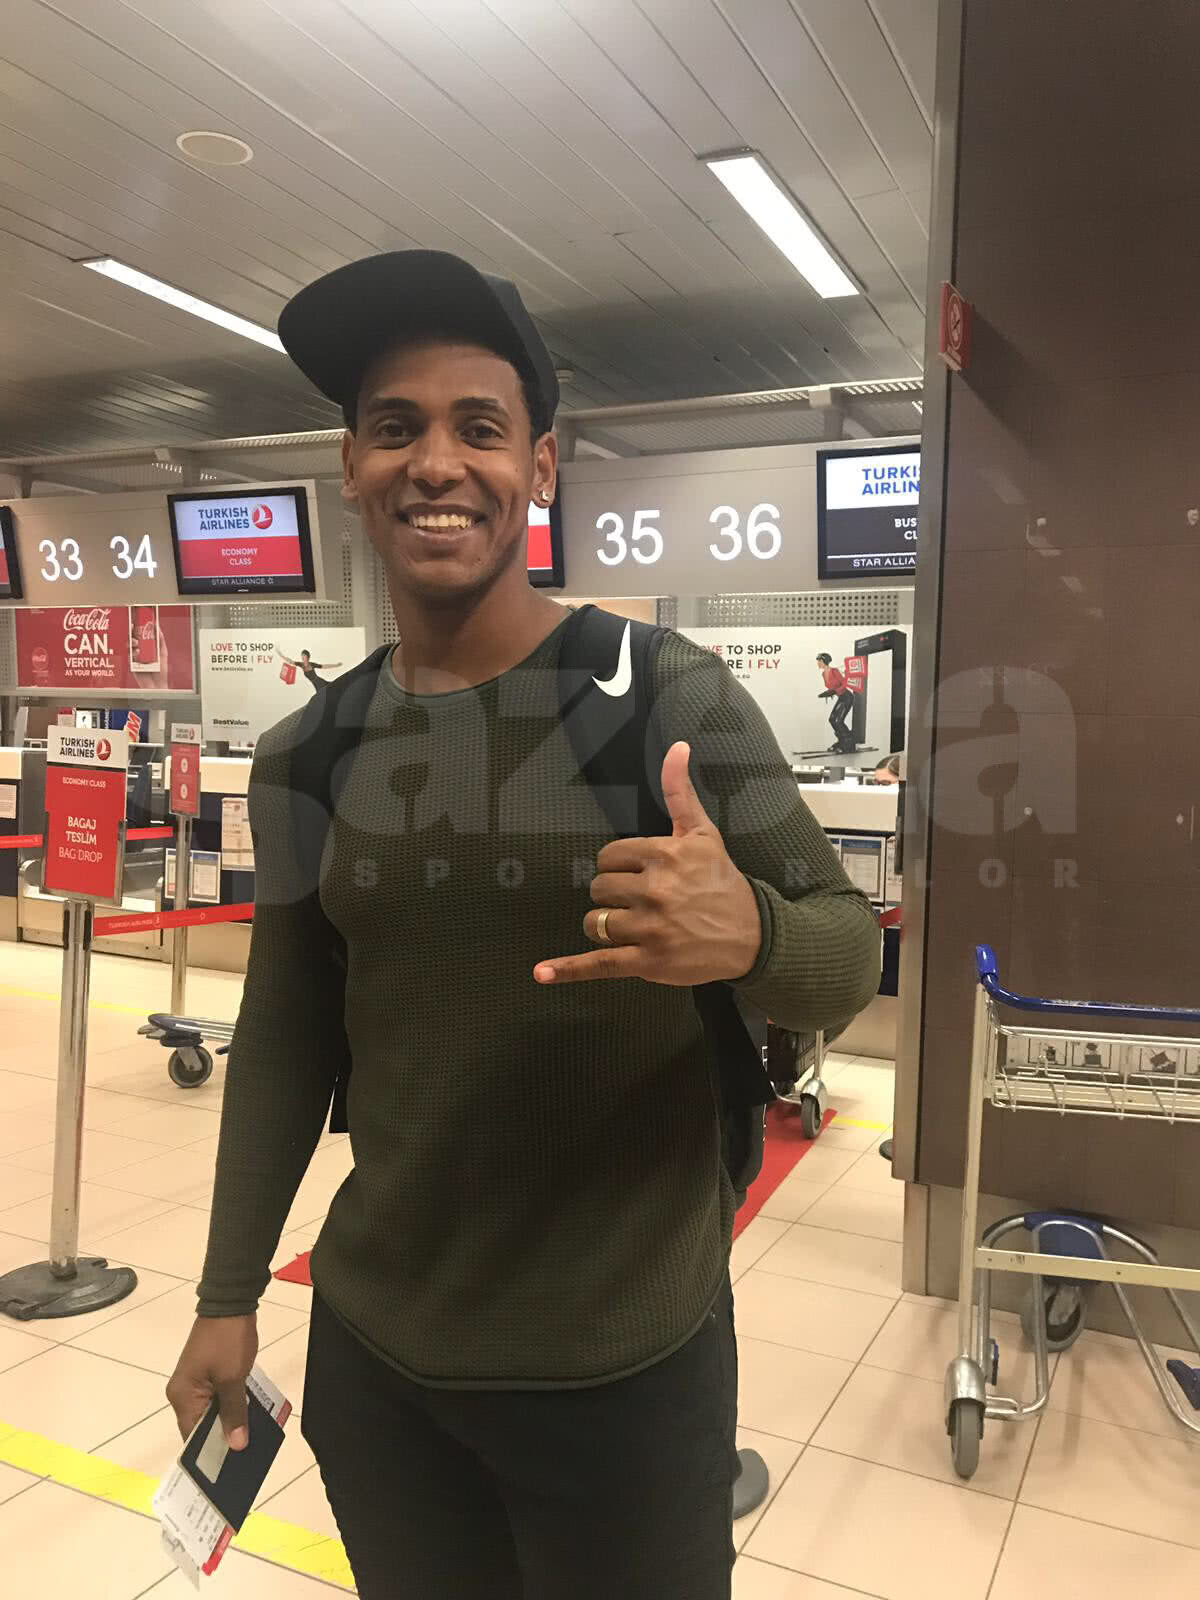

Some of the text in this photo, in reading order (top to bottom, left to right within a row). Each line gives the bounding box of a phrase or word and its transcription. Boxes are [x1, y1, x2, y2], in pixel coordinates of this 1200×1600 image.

[862, 465, 920, 480] TURKI
[198, 507, 249, 519] TURKISH
[200, 519, 250, 530] AIRLINES
[894, 518, 917, 528] BUS
[595, 509, 664, 566] 35
[709, 503, 782, 561] 36
[110, 534, 158, 580] 34
[222, 548, 258, 556] ECONOMY
[39, 538, 84, 582] 33
[229, 558, 252, 566] CLASS
[853, 558, 881, 567] STAR
[64, 633, 114, 655] CAN.
[211, 643, 274, 651] LOVE TO SHOP
[726, 644, 744, 655] TO
[747, 644, 782, 655] SHOP
[211, 655, 248, 664] BEFORE
[257, 655, 273, 663] FLY
[748, 659, 752, 669] I
[757, 659, 781, 669] FLY
[65, 669, 73, 677] AS
[74, 669, 91, 677] YOUR
[60, 737, 95, 748] TURKISH
[60, 747, 95, 758] AIRLINES
[62, 776, 106, 788] ECONOMY CLASS
[67, 816, 97, 830] BAGAJ
[59, 846, 103, 863] BAG DROP
